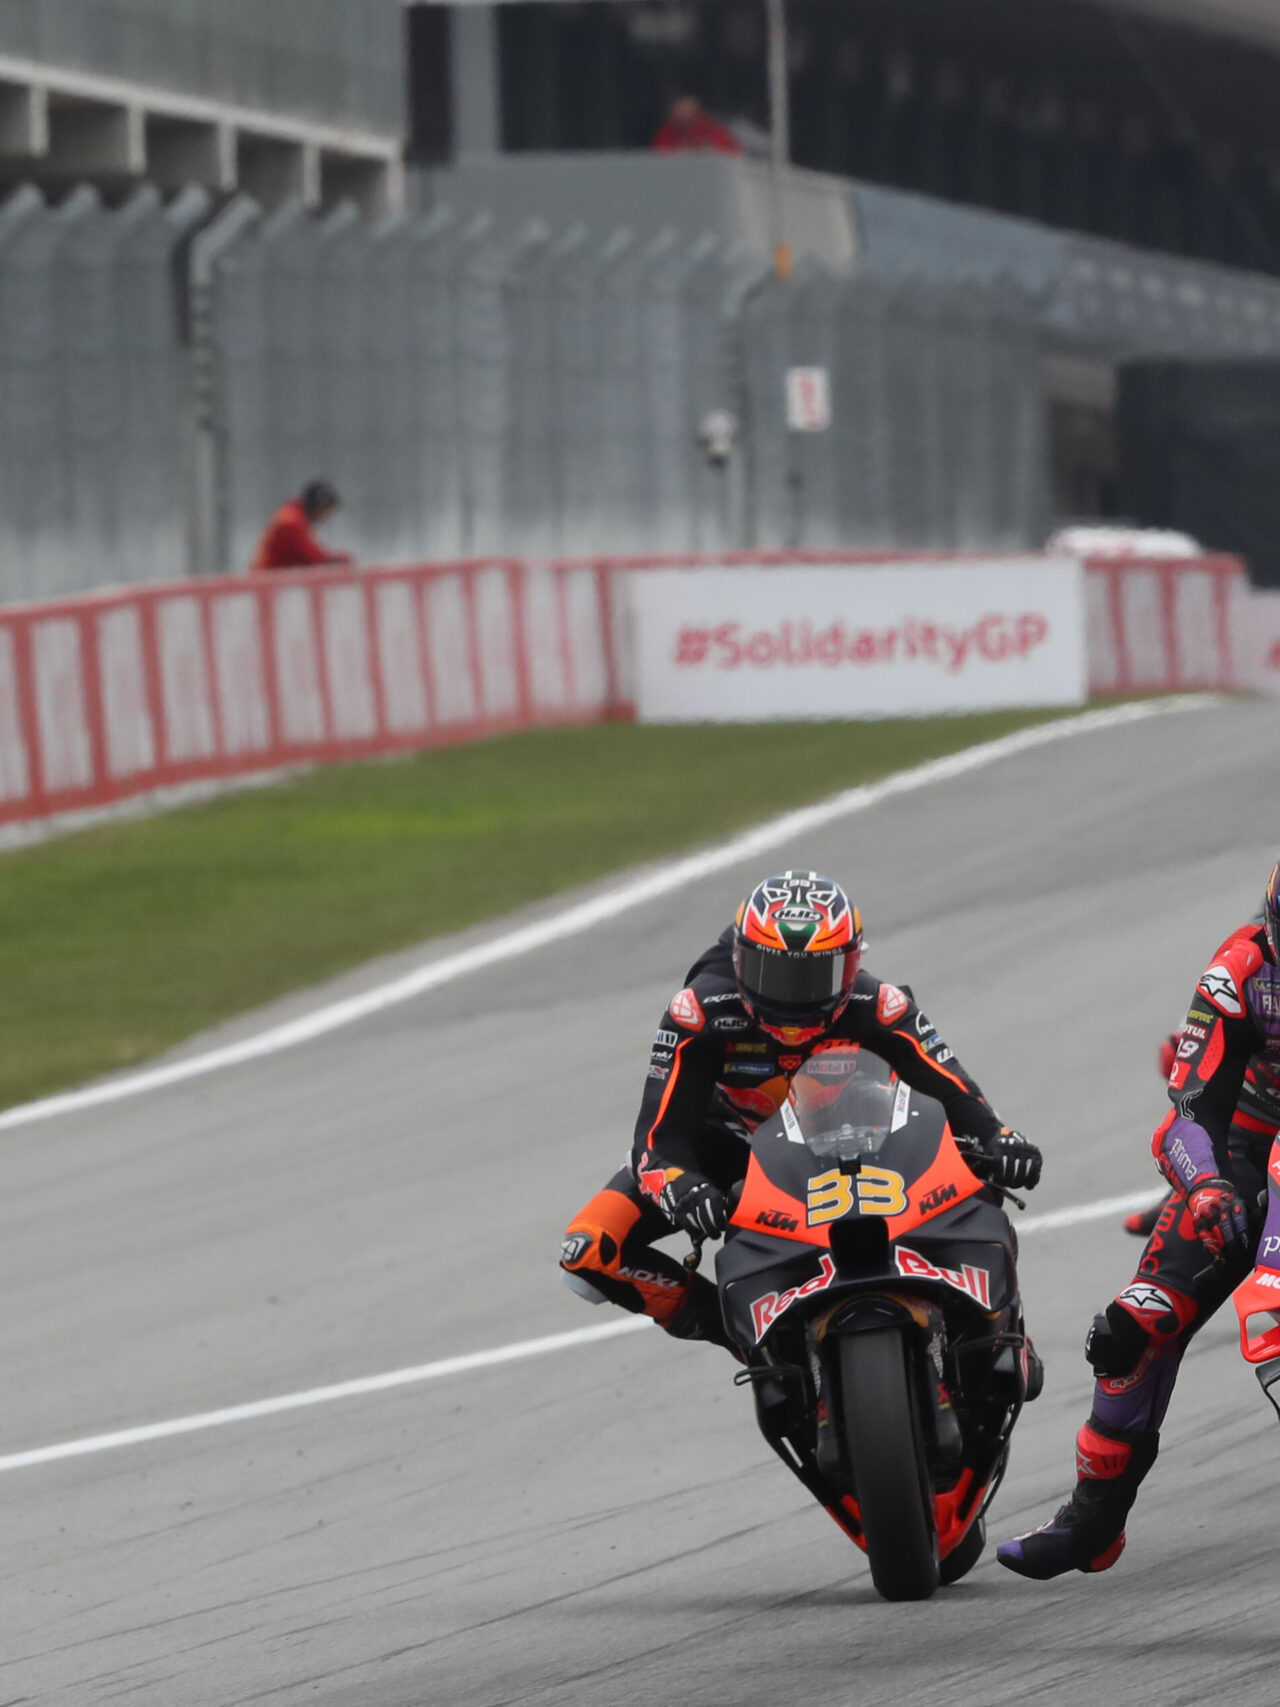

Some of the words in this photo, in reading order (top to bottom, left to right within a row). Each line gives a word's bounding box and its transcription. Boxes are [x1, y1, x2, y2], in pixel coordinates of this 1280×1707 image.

[675, 612, 1049, 673] #SolidarityGP
[778, 910, 819, 921] HJC
[808, 1063, 842, 1073] Mobil
[1170, 1138, 1198, 1180] prima
[807, 1164, 908, 1227] 33
[918, 1183, 958, 1215] KTM
[755, 1209, 800, 1233] KTM
[750, 1251, 836, 1345] Red
[894, 1245, 992, 1311] Bull
